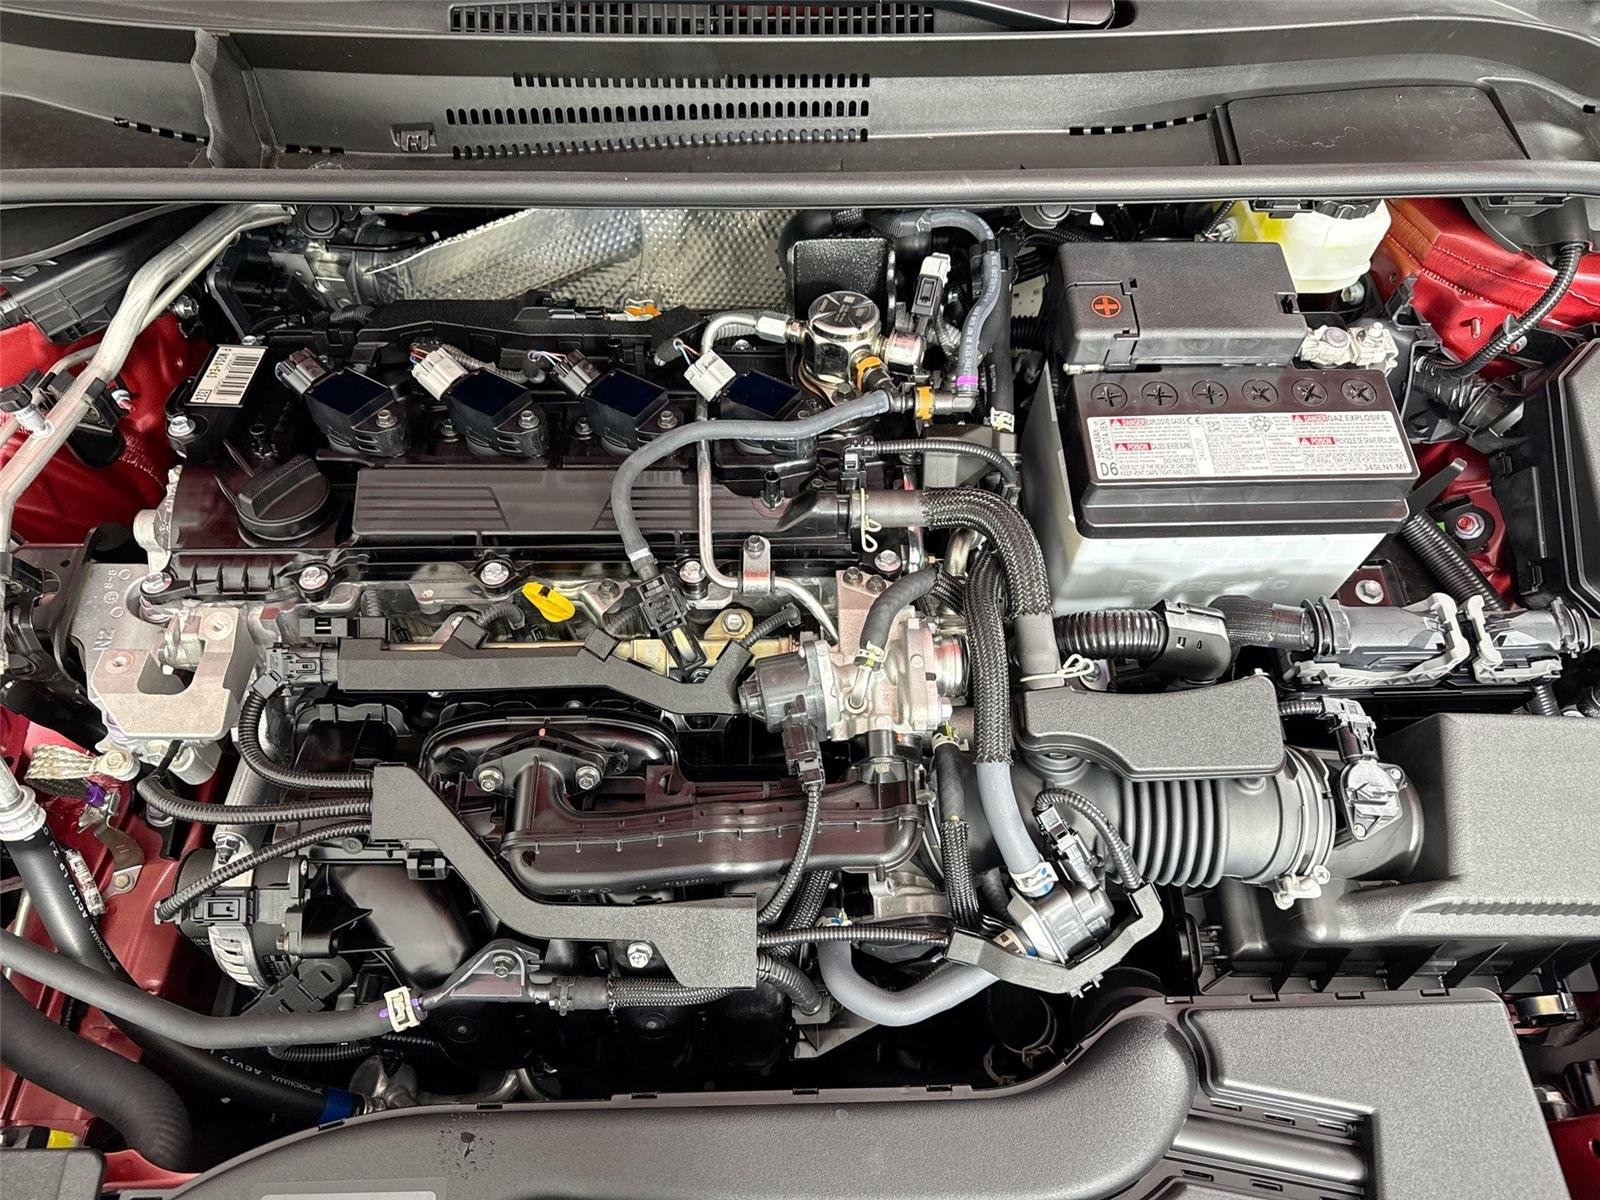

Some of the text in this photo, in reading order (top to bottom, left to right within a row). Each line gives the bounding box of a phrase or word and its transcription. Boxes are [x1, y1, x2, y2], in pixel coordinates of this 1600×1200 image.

[1328, 414, 1344, 422] GAZ
[1311, 437, 1332, 445] POISON
[1100, 462, 1119, 476] D6
[68, 884, 89, 919] ACV17
[89, 924, 112, 961] YOKOHAMA
[221, 1055, 312, 1092] YOKOHAMA ACV17
